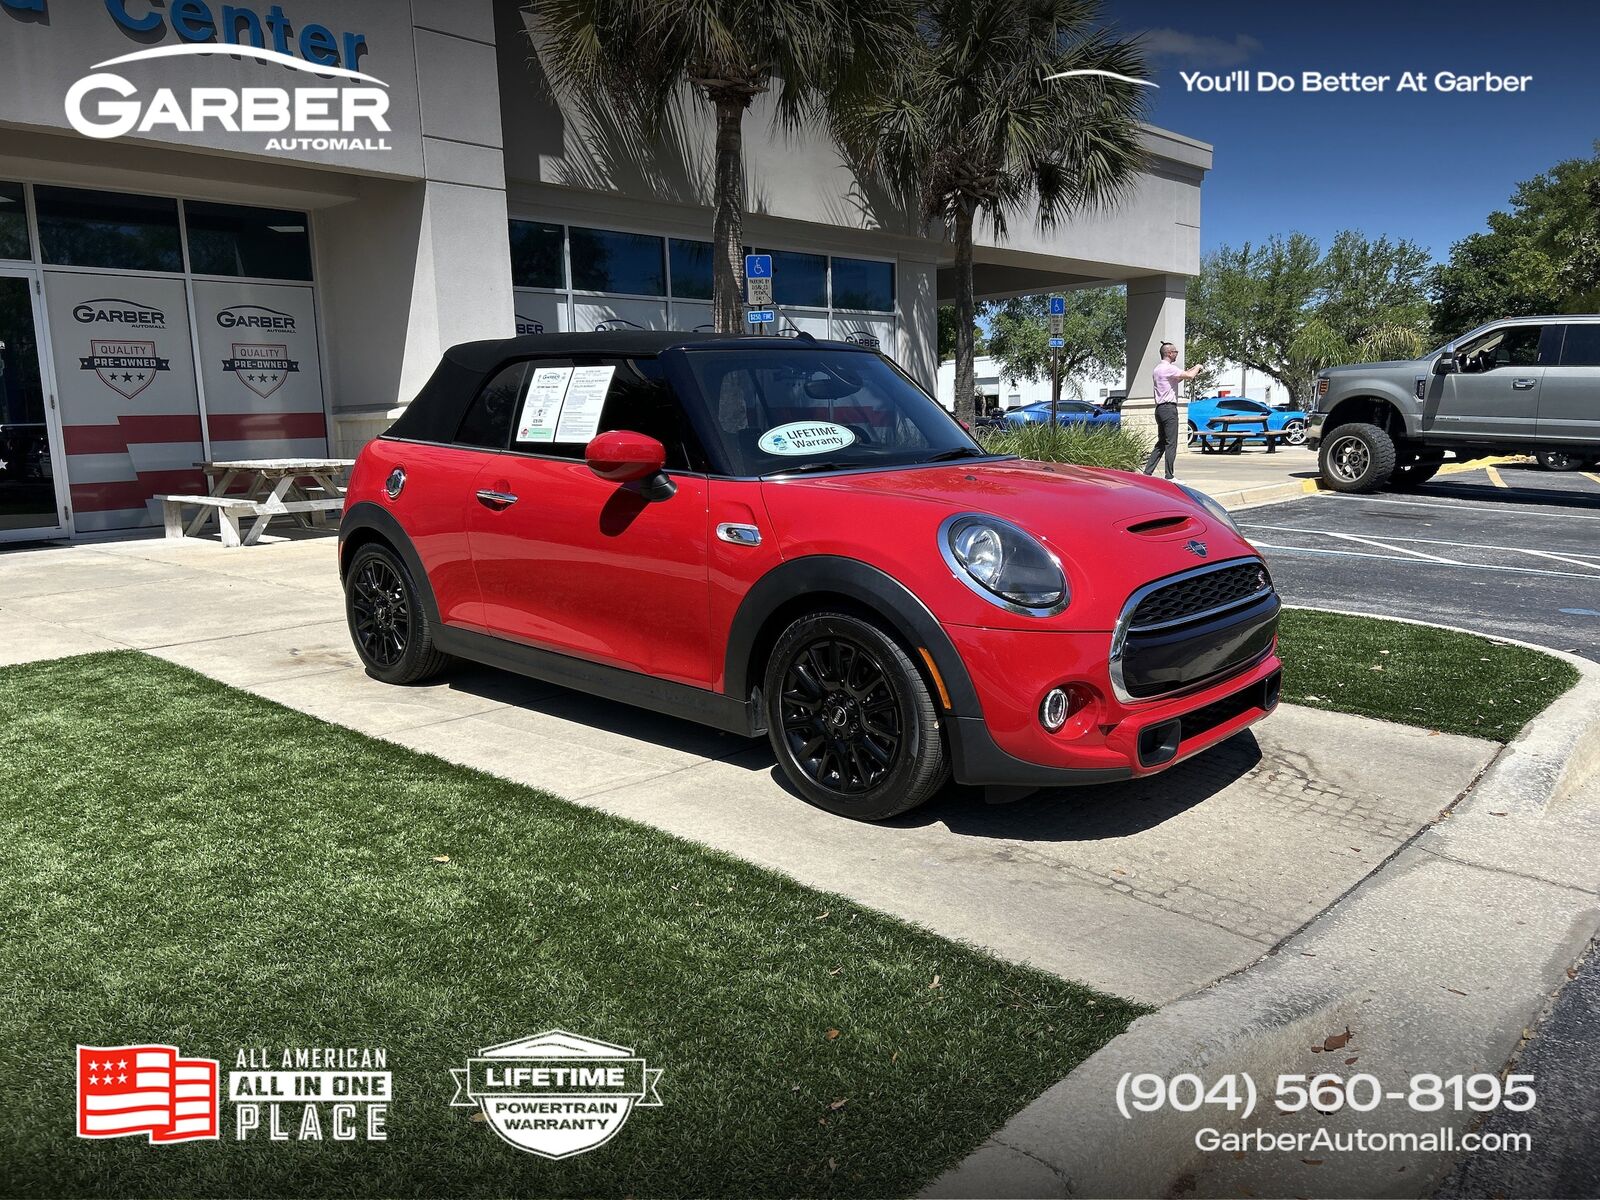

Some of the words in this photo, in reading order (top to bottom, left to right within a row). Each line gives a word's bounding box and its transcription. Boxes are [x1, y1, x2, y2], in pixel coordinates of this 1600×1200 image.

[106, 0, 367, 76] Center
[516, 324, 544, 335] BER
[101, 345, 146, 355] QUALITY
[240, 349, 279, 358] QUALITY
[94, 358, 157, 367] PRE-OWNED
[234, 361, 288, 369] PRE-OWNED
[787, 426, 838, 440] LIFETIME
[793, 437, 843, 448] Warranty
